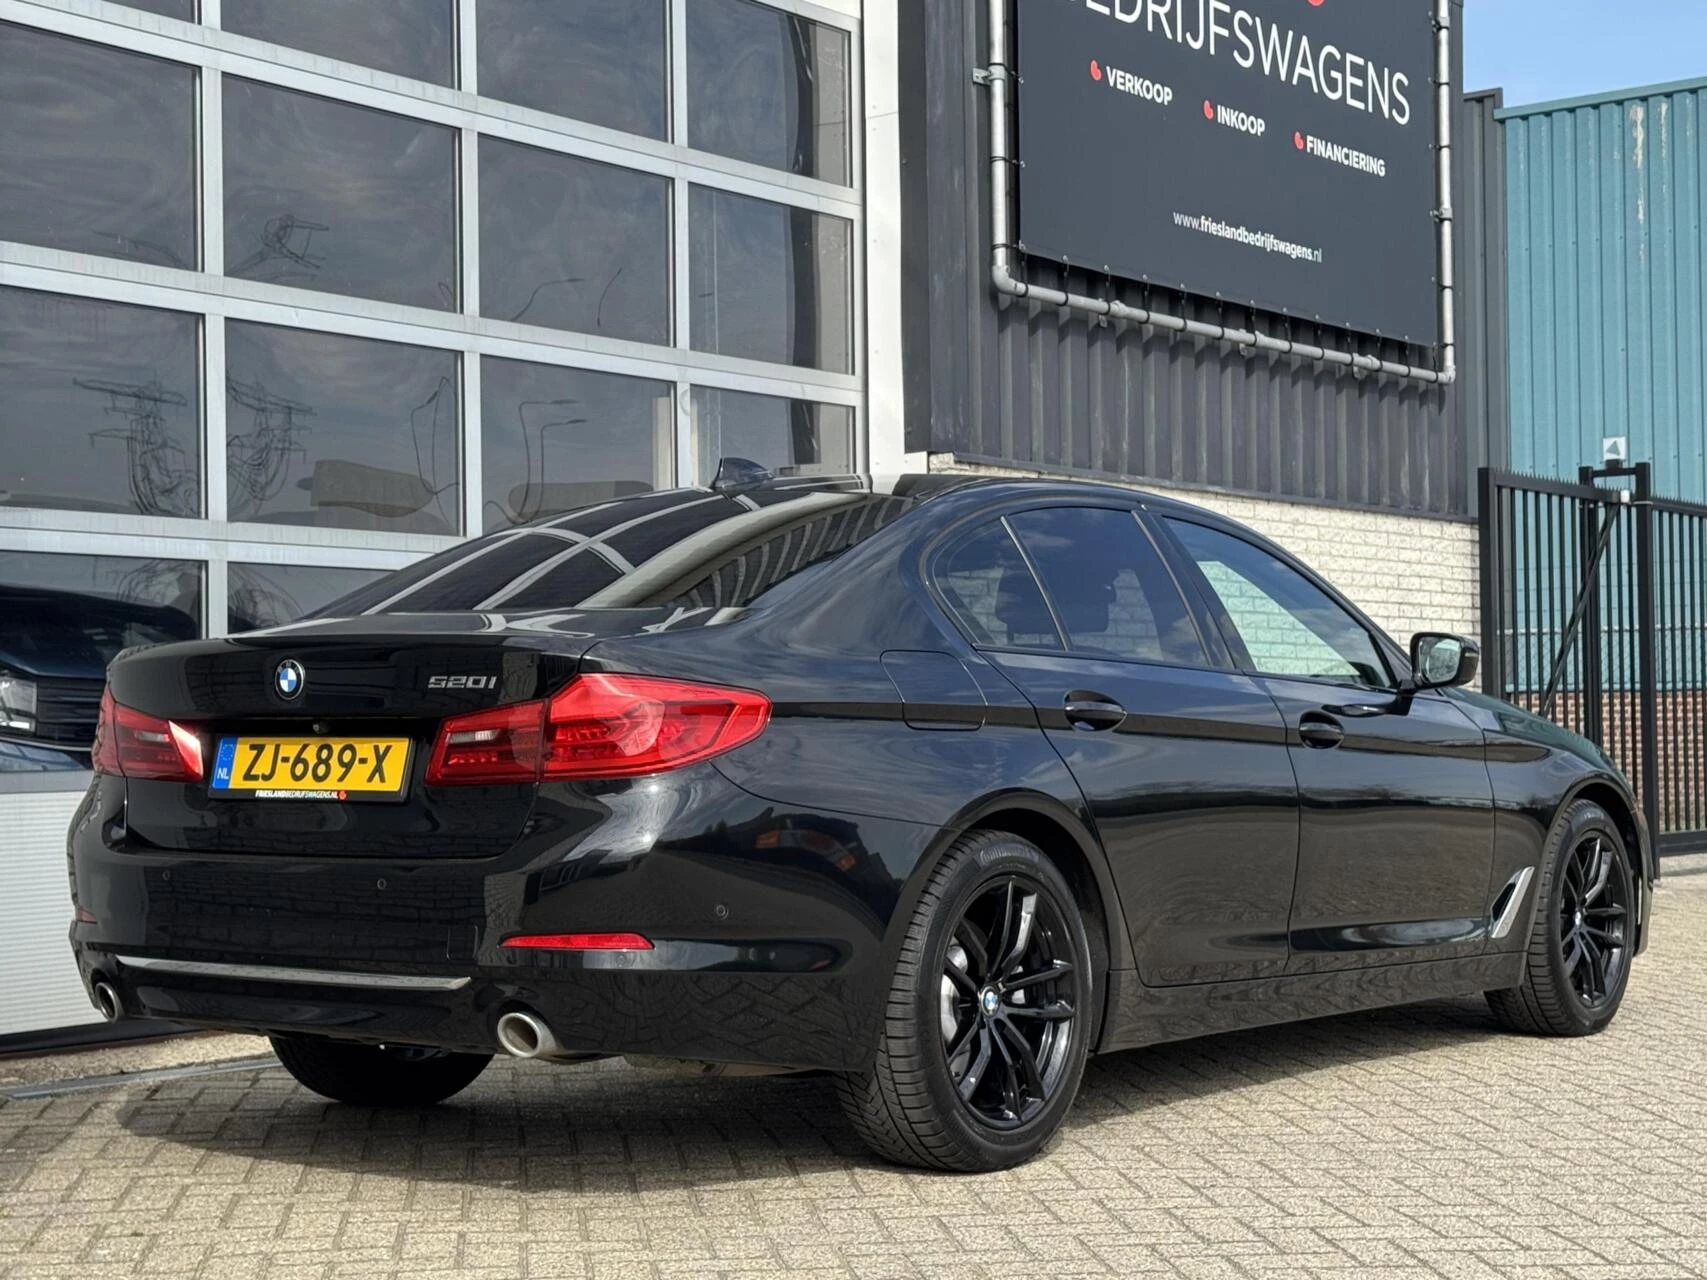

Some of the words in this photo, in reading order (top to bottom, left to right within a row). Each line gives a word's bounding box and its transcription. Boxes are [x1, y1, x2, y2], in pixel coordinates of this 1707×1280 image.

[1069, 0, 1410, 125] RIJFSWAGENS
[1106, 66, 1173, 106] VERKOOP
[1217, 104, 1266, 137] INKOOP
[1306, 135, 1386, 177] FINANCIERING
[1173, 211, 1323, 263] www.frieslandbedrijfswagens.nl
[217, 767, 229, 780] NL
[243, 743, 393, 783] ZJ-689-X
